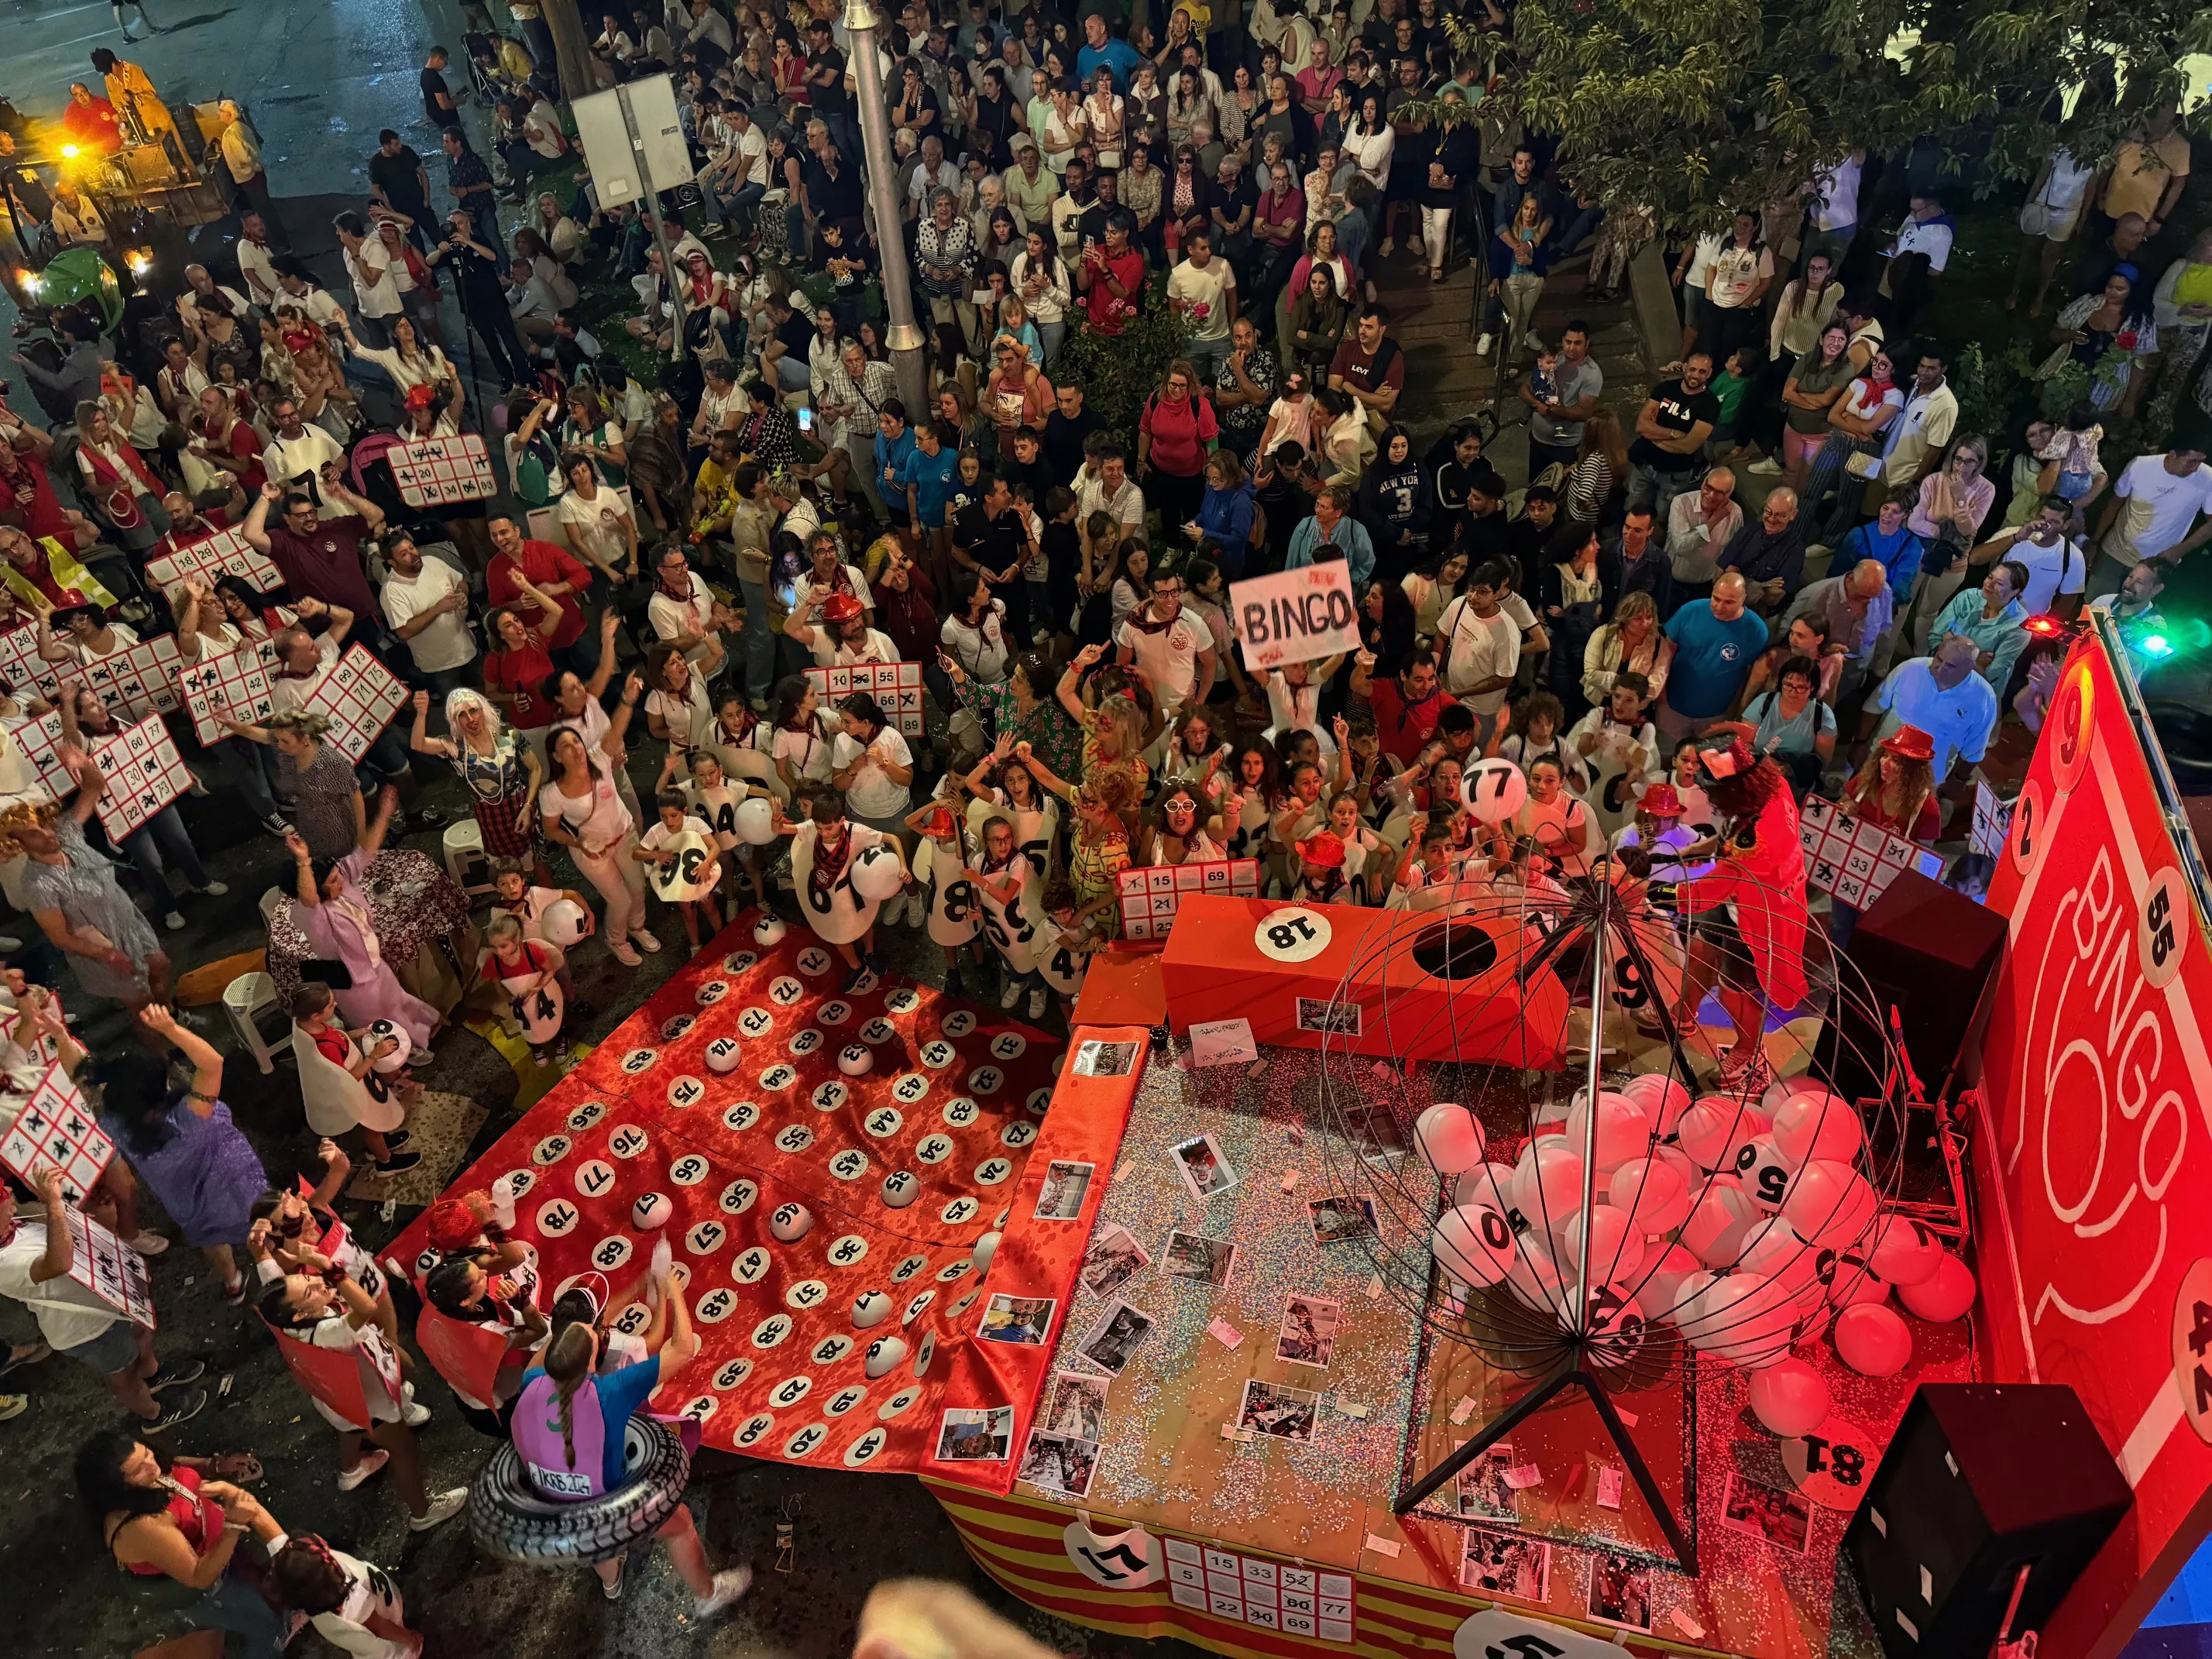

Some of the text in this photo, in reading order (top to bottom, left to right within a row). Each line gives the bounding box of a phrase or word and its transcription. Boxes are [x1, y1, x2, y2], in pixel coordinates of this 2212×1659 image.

[1659, 397, 1691, 421] FILA
[1379, 475, 1420, 494] NEW YOR
[1396, 487, 1413, 513] 3
[1243, 589, 1352, 644] BINGO
[353, 650, 366, 665] 73
[249, 678, 262, 690] 42
[339, 670, 352, 683] 69
[369, 668, 384, 685] 75
[833, 675, 847, 686] 10
[879, 672, 894, 682] 55
[355, 685, 371, 702] 71
[881, 696, 895, 706] 66
[193, 702, 206, 713] 10
[239, 710, 252, 722] 33
[46, 720, 61, 733] 53
[149, 723, 160, 737] 77
[362, 719, 376, 733] 33
[904, 720, 919, 730] 89
[131, 737, 143, 750] 60
[125, 768, 140, 785] 30
[155, 781, 170, 799] 73
[1462, 768, 1514, 804] 77
[126, 805, 140, 822] 22
[2019, 796, 2032, 857] 2
[1887, 842, 1906, 859] 51
[1850, 856, 1868, 872] 33
[1153, 876, 1170, 886] 15
[1207, 871, 1224, 881] 69
[1841, 881, 1860, 896] 43
[1135, 926, 1143, 935] 5
[1267, 915, 1317, 950] 18
[2148, 884, 2177, 967] 55
[729, 954, 753, 970] 82
[801, 953, 825, 970] 71
[700, 984, 723, 1001] 83
[775, 982, 799, 1001] 72
[889, 992, 912, 1008] 51
[744, 1010, 768, 1030] 73
[823, 1004, 845, 1020] 62
[667, 1015, 691, 1037] 84
[864, 1021, 888, 1039] 52
[946, 1014, 968, 1031] 41
[711, 1039, 735, 1056] 74
[795, 1032, 817, 1049] 63
[997, 1037, 1018, 1054] 31
[627, 1051, 651, 1070] 85
[843, 1044, 868, 1062] 53
[926, 1043, 947, 1063] 42
[764, 1070, 788, 1087] 64
[974, 1070, 996, 1090] 32
[675, 1082, 699, 1103] 75
[817, 1084, 841, 1106] 54
[898, 1078, 921, 1098] 43
[572, 1106, 599, 1127] 86
[729, 1106, 752, 1126] 65
[950, 1102, 971, 1121] 33
[871, 1111, 895, 1132] 44
[614, 1130, 641, 1154] 76
[782, 1128, 809, 1148] 55
[1007, 1125, 1029, 1142] 23
[542, 1139, 565, 1161] 87
[919, 1140, 945, 1159] 34
[675, 1159, 700, 1180] 66
[836, 1152, 860, 1176] 45
[980, 1163, 1005, 1180] 24
[584, 1166, 610, 1192] 77
[886, 1171, 909, 1192] 35
[636, 1194, 658, 1215] 67
[726, 1184, 751, 1208] 56
[544, 1204, 575, 1229] 78
[776, 1204, 799, 1225] 46
[946, 1201, 970, 1219] 25
[695, 1223, 721, 1249] 57
[597, 1242, 623, 1265] 68
[835, 1240, 861, 1261] 36
[740, 1252, 761, 1279] 47
[897, 1260, 922, 1277] 26
[944, 1264, 968, 1277] 16
[795, 1284, 820, 1304] 37
[702, 1290, 730, 1317] 48
[910, 1297, 928, 1315] 17
[617, 1307, 644, 1333] 59
[757, 1321, 784, 1344] 38
[817, 1340, 844, 1359] 28
[922, 1346, 929, 1363] 8
[719, 1363, 746, 1386] 39
[779, 1380, 806, 1401] 29
[832, 1393, 857, 1412] 19
[892, 1397, 909, 1407] 9
[740, 1419, 768, 1443] 30
[791, 1429, 821, 1453] 20
[855, 1436, 879, 1458] 10
[1800, 1433, 1865, 1487] 81
[1212, 1556, 1233, 1569] 15
[1183, 1570, 1194, 1580] 5
[1249, 1566, 1272, 1578] 33
[1285, 1573, 1308, 1587] 52
[1216, 1600, 1238, 1613] 22
[1286, 1598, 1310, 1610] 60
[1324, 1602, 1346, 1614] 77
[1250, 1610, 1273, 1623] 40
[1287, 1617, 1310, 1630] 69
